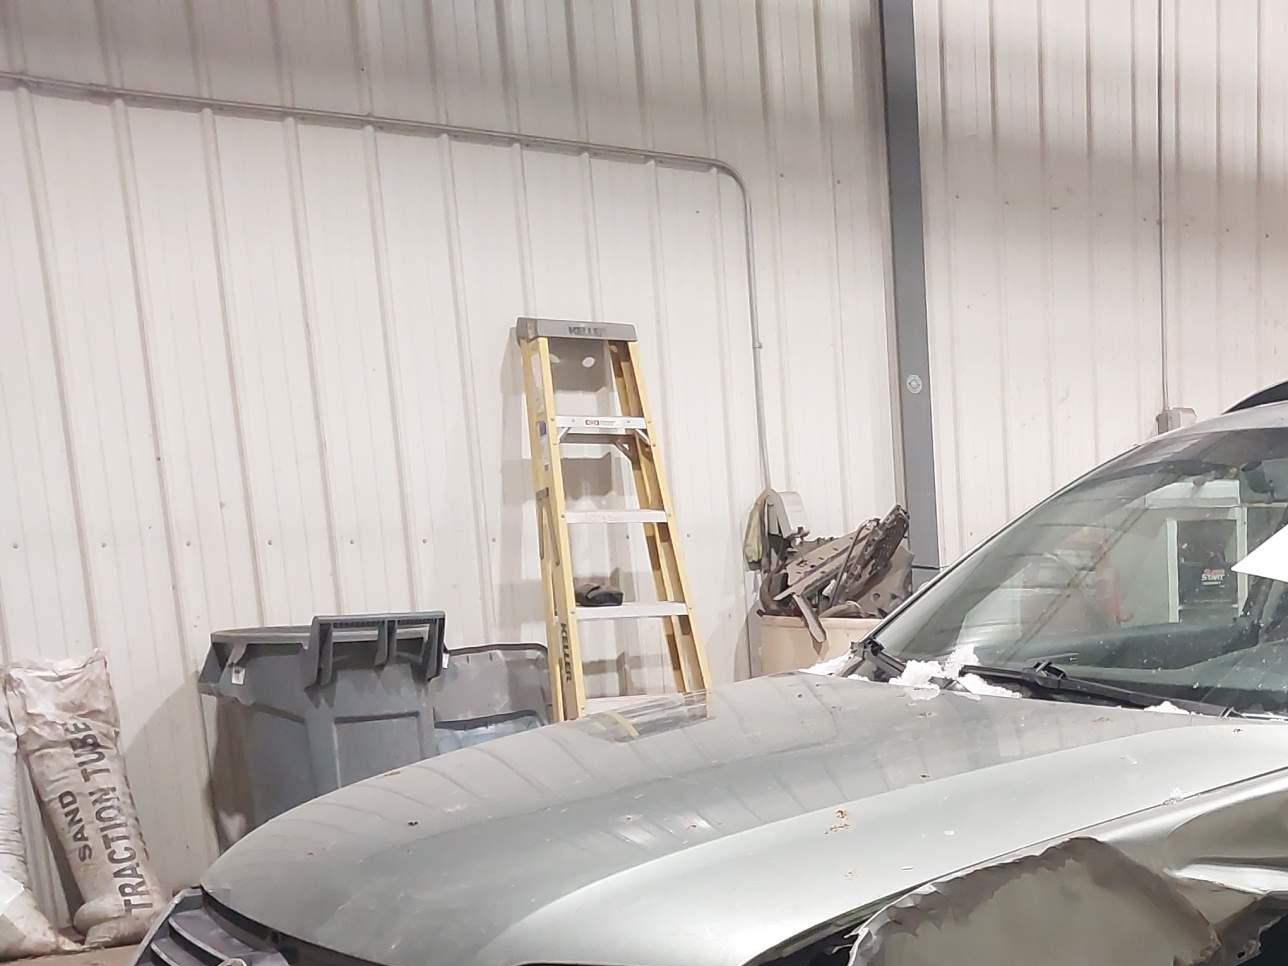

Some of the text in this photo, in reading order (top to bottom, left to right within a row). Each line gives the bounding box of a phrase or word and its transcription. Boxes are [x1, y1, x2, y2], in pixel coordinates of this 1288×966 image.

[560, 623, 572, 682] KELLER
[64, 721, 112, 784] TUBE
[58, 790, 94, 863] SAND
[90, 785, 153, 915] TRACTION
